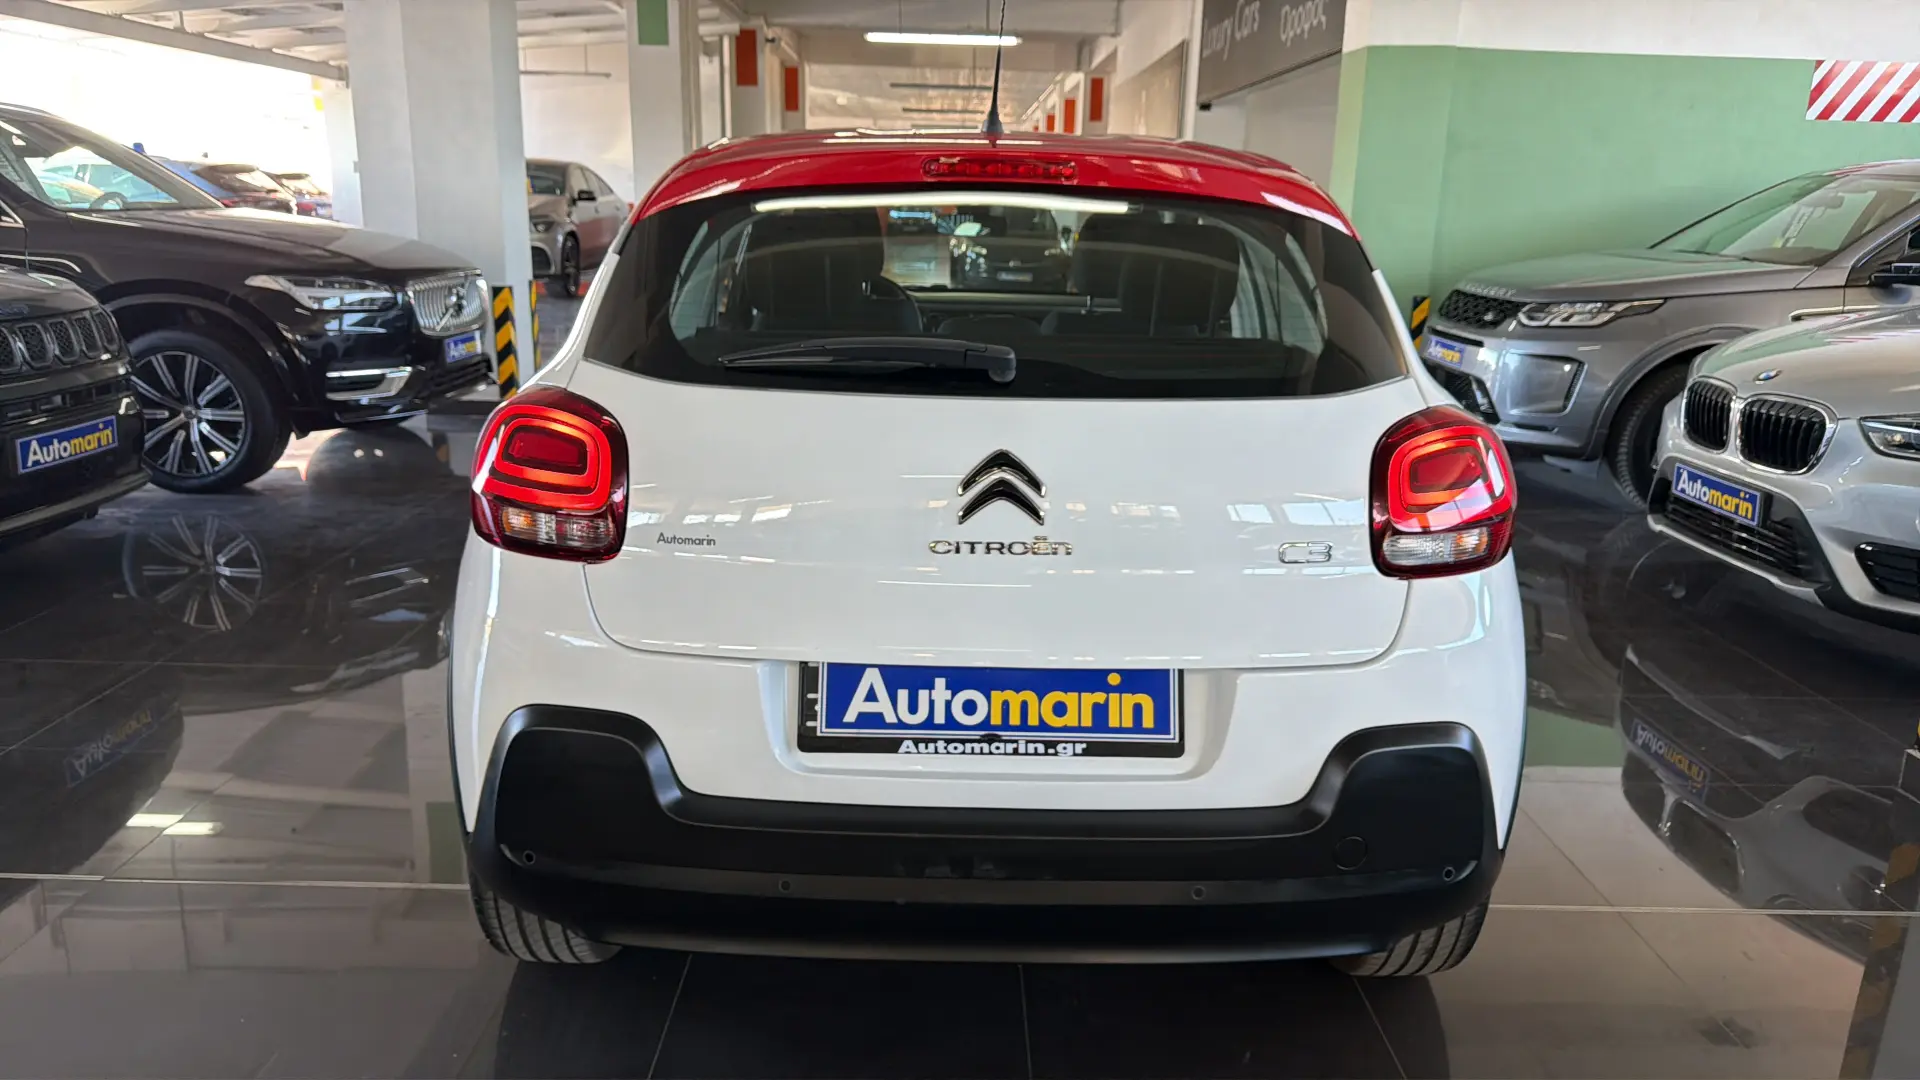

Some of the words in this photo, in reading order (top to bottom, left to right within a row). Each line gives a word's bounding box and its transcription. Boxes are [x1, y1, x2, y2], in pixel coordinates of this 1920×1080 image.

[1234, 0, 1261, 41] Cars
[27, 423, 113, 467] Automarin
[1677, 468, 1753, 519] Automarin
[656, 532, 716, 546] Automarin
[1278, 541, 1332, 564] C3
[842, 667, 1154, 729] Automarin
[898, 739, 1087, 757] Automarin.gr
